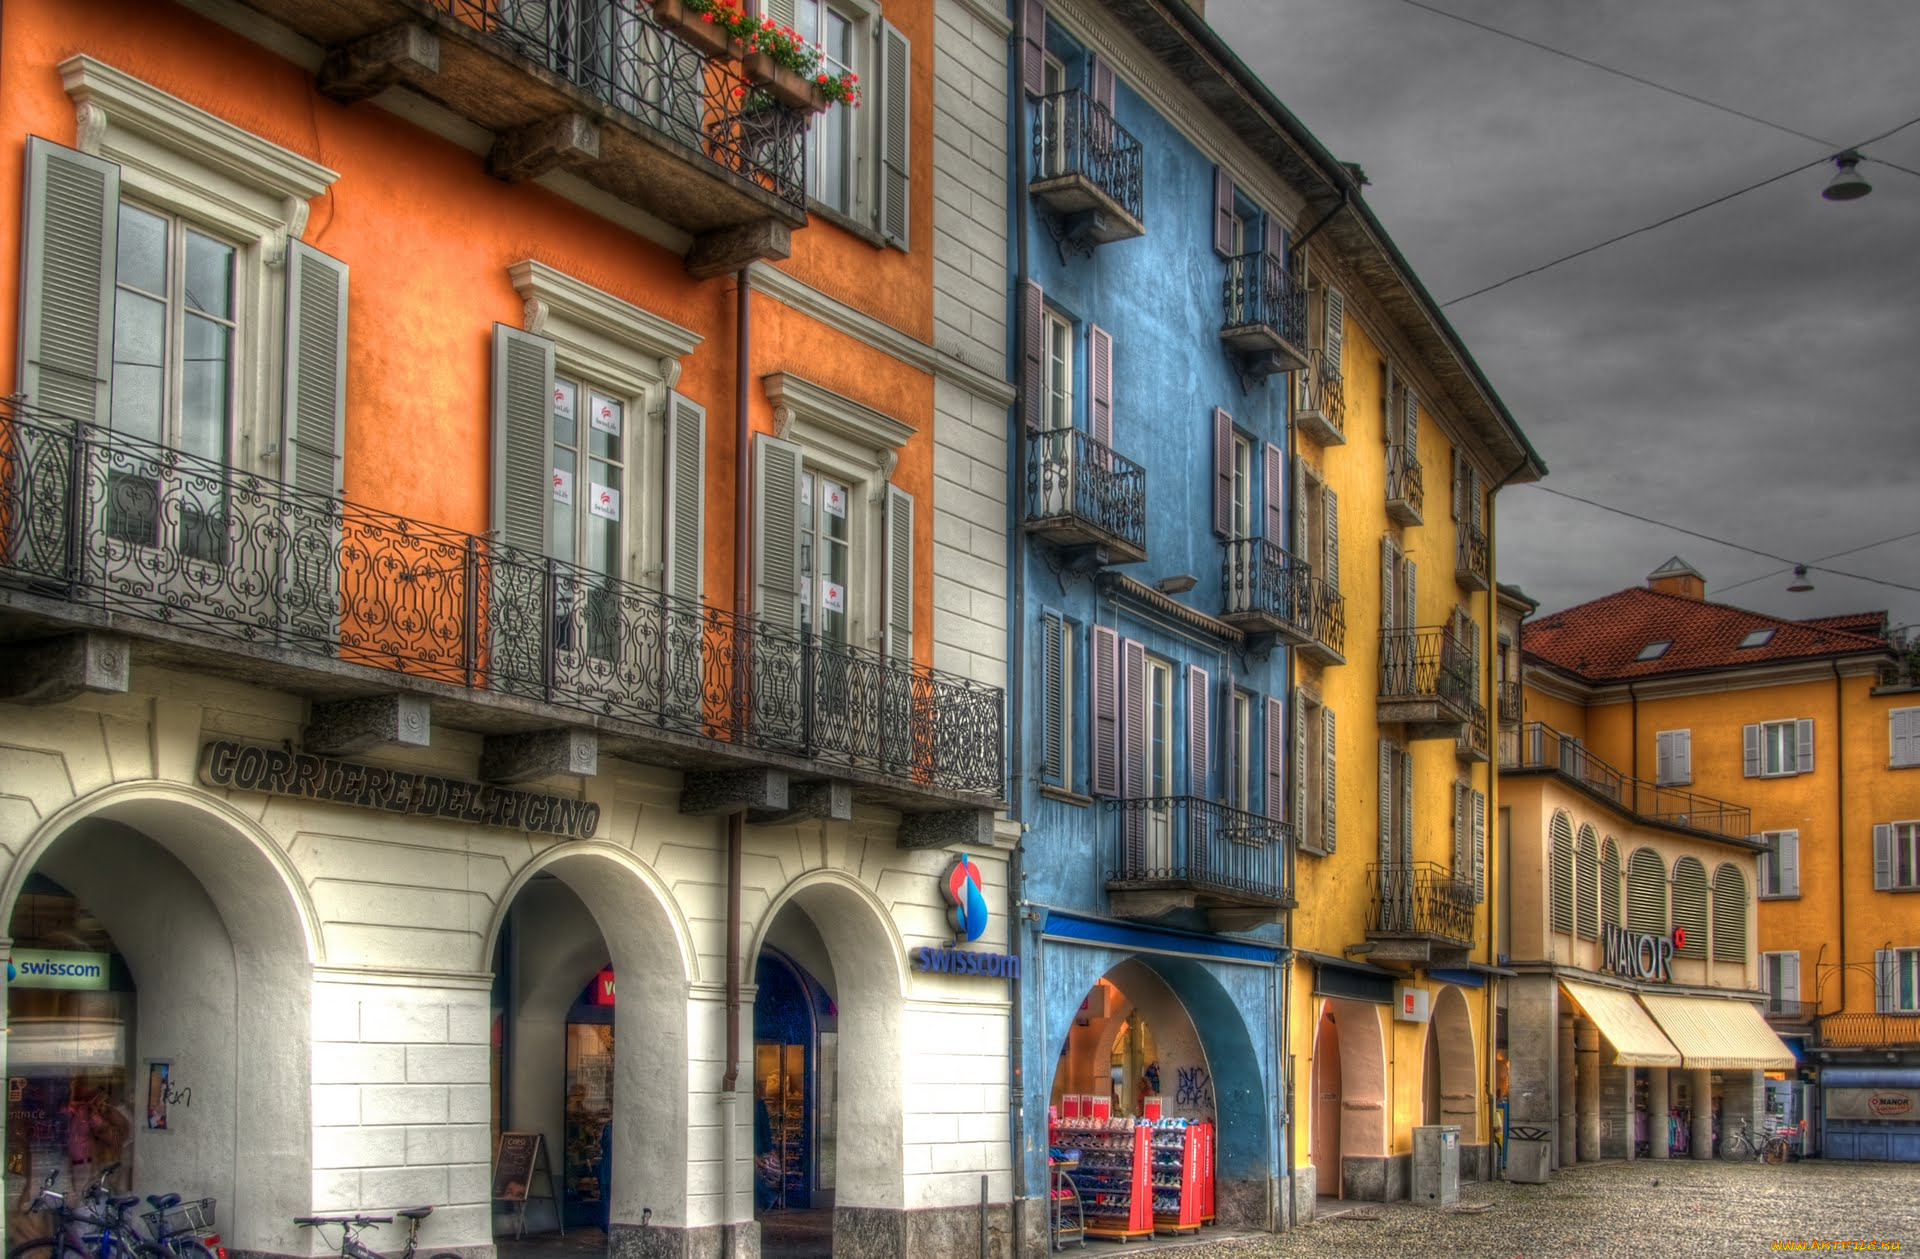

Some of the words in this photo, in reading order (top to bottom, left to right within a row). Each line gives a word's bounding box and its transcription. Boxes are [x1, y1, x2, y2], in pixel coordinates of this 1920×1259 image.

[209, 739, 417, 815] CORRIERE
[415, 773, 484, 823] DEL
[484, 785, 601, 840] TICINO
[20, 958, 101, 978] swisscom
[919, 940, 1020, 979] swisscom
[1603, 922, 1674, 984] MANOR
[604, 980, 616, 996] V
